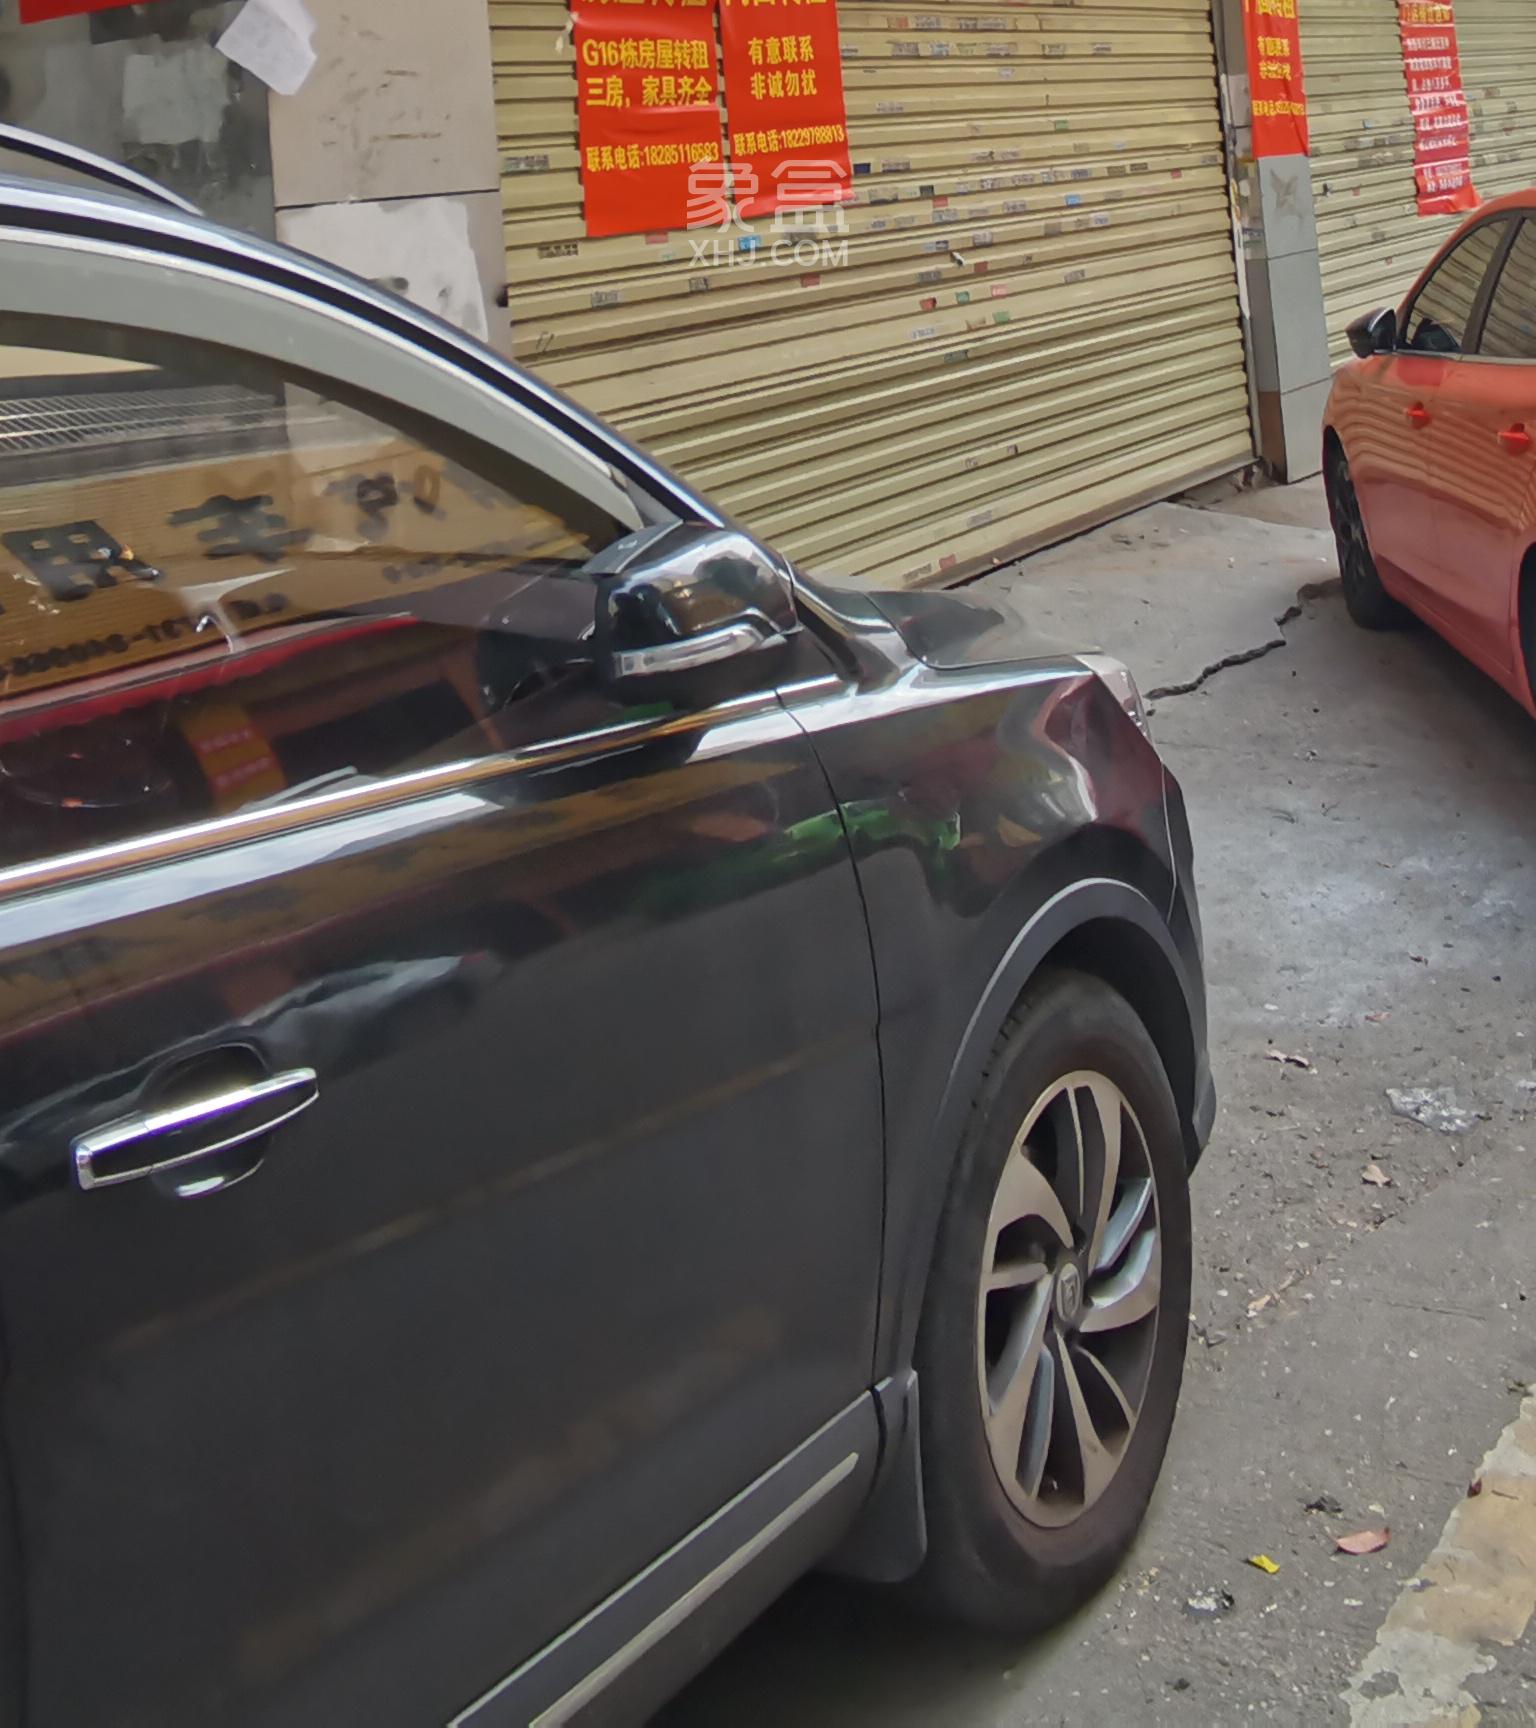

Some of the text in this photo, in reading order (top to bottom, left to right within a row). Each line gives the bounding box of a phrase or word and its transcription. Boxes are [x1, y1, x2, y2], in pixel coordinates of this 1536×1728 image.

[582, 37, 710, 71] G16栋房屋转租
[748, 34, 815, 66] 有意联系
[750, 68, 818, 101] 非诚勿扰
